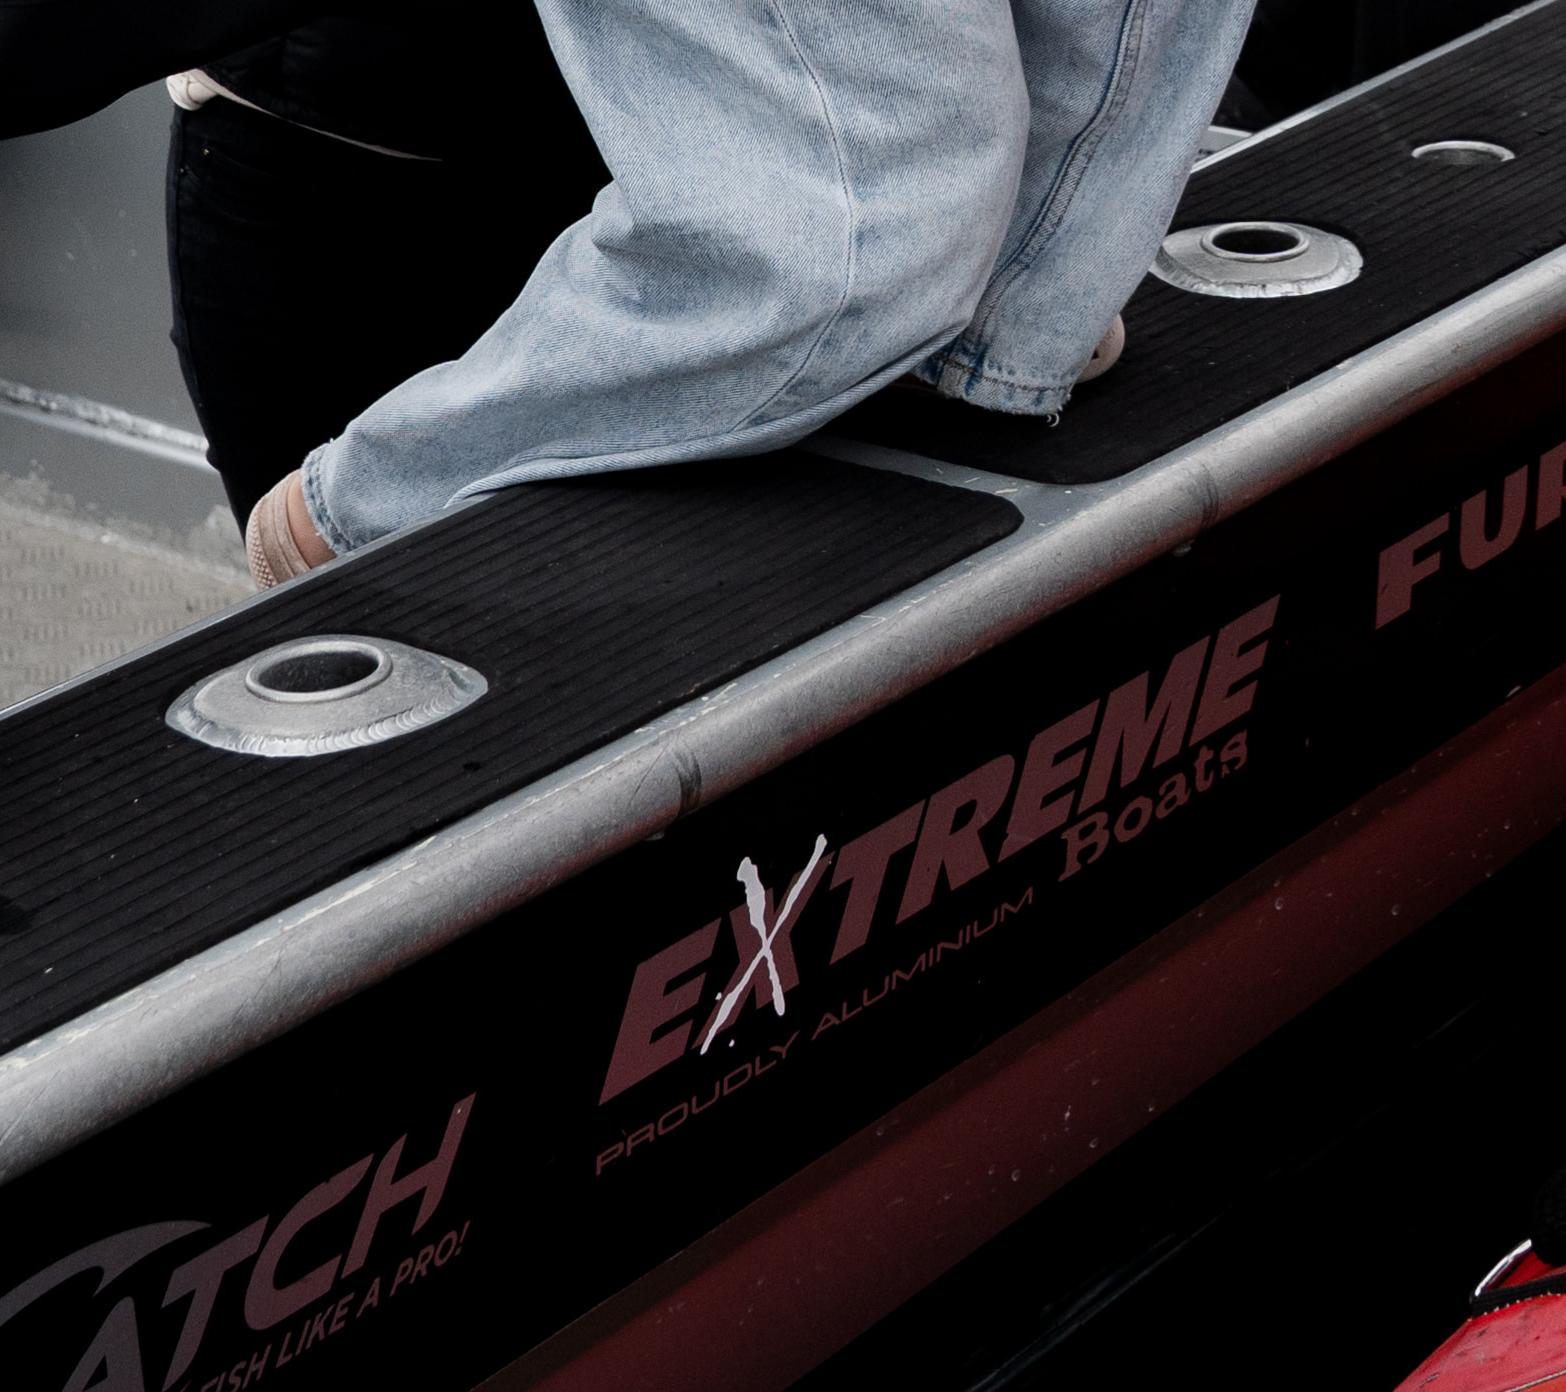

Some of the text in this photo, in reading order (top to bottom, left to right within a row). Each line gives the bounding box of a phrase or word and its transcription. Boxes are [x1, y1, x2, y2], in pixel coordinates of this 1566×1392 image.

[598, 592, 1282, 1107] EXTREME
[1057, 728, 1251, 883] Boats
[595, 884, 1034, 1177] PROUDLY ALUMINIUM
[274, 1289, 356, 1369] LIKE
[354, 1273, 383, 1320] A
[387, 1217, 472, 1300] PRO!
